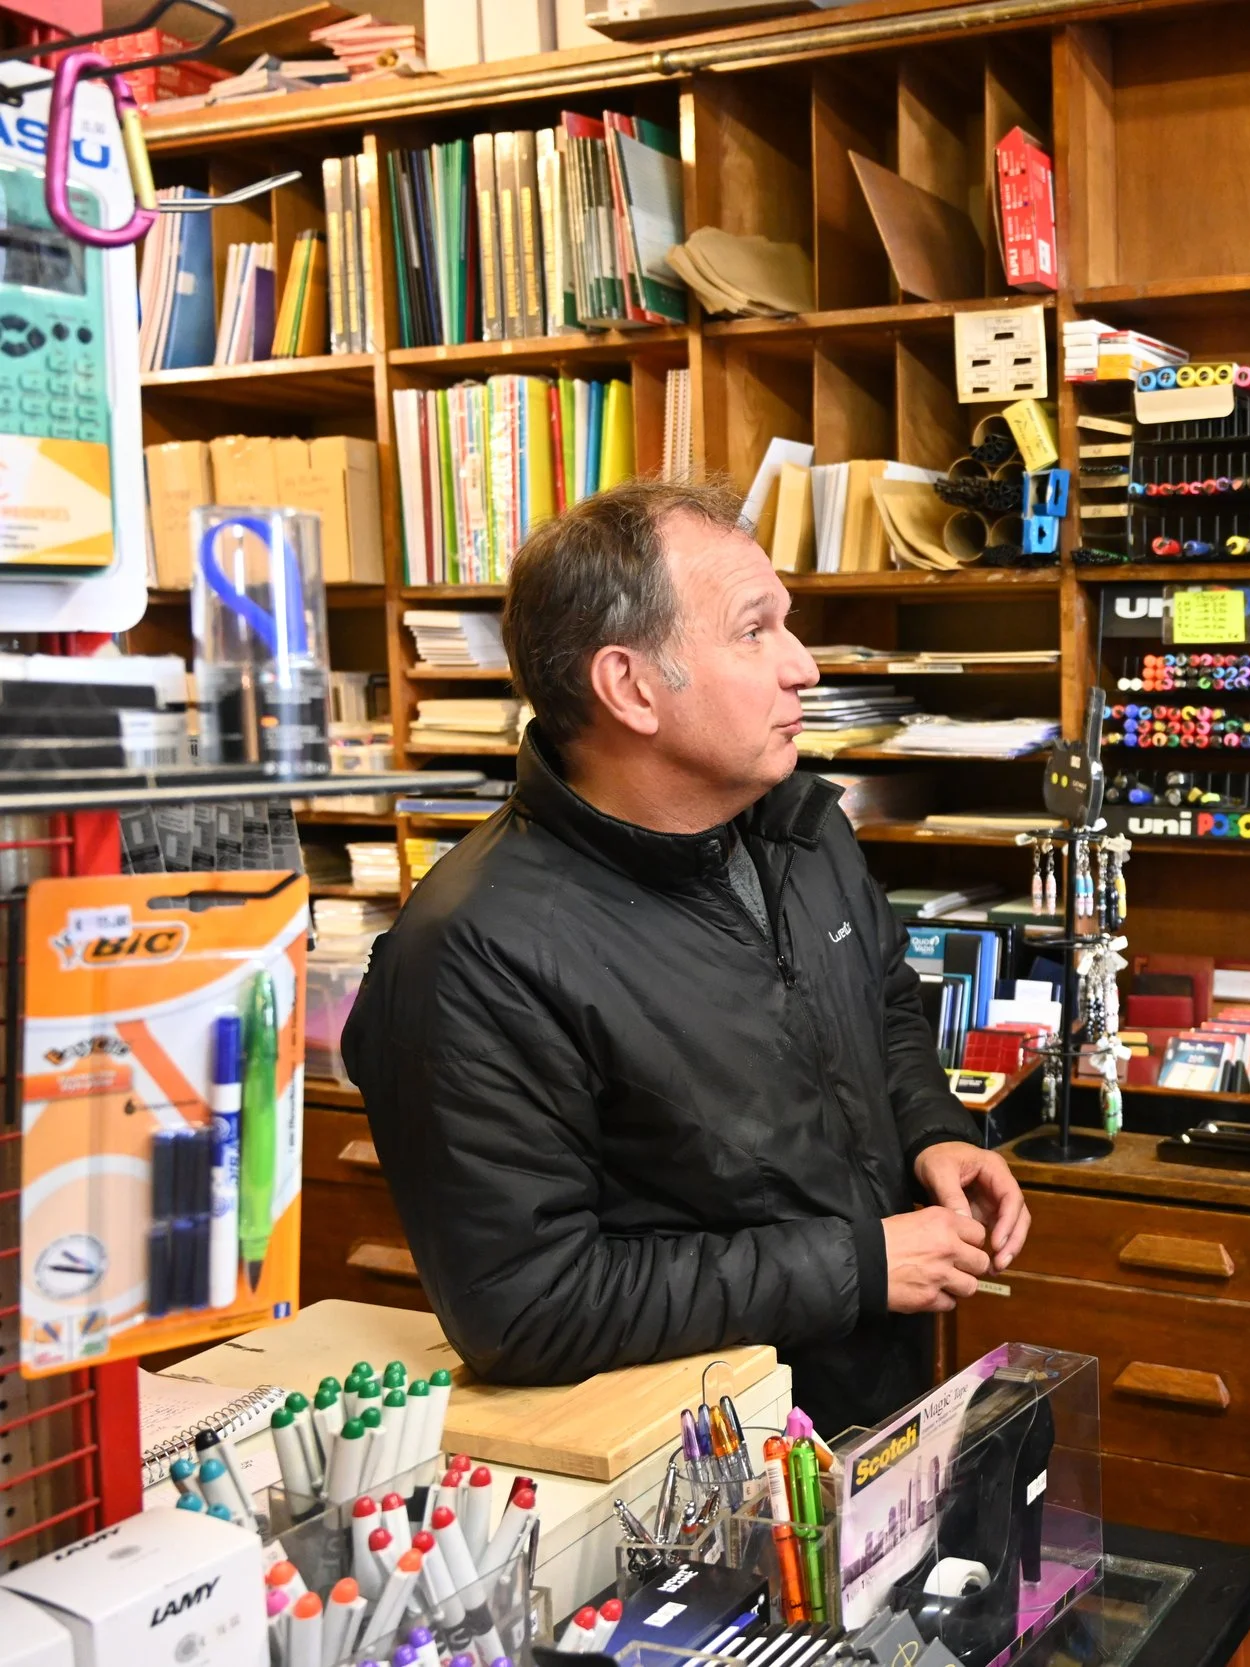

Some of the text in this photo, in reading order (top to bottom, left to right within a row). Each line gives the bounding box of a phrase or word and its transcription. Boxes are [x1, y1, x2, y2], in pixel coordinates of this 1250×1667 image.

[1128, 811, 1192, 836] uni
[855, 1422, 918, 1486] Scotch
[922, 1391, 952, 1423] Magic
[953, 1383, 970, 1401] Tape
[149, 1575, 221, 1628] LAMY
